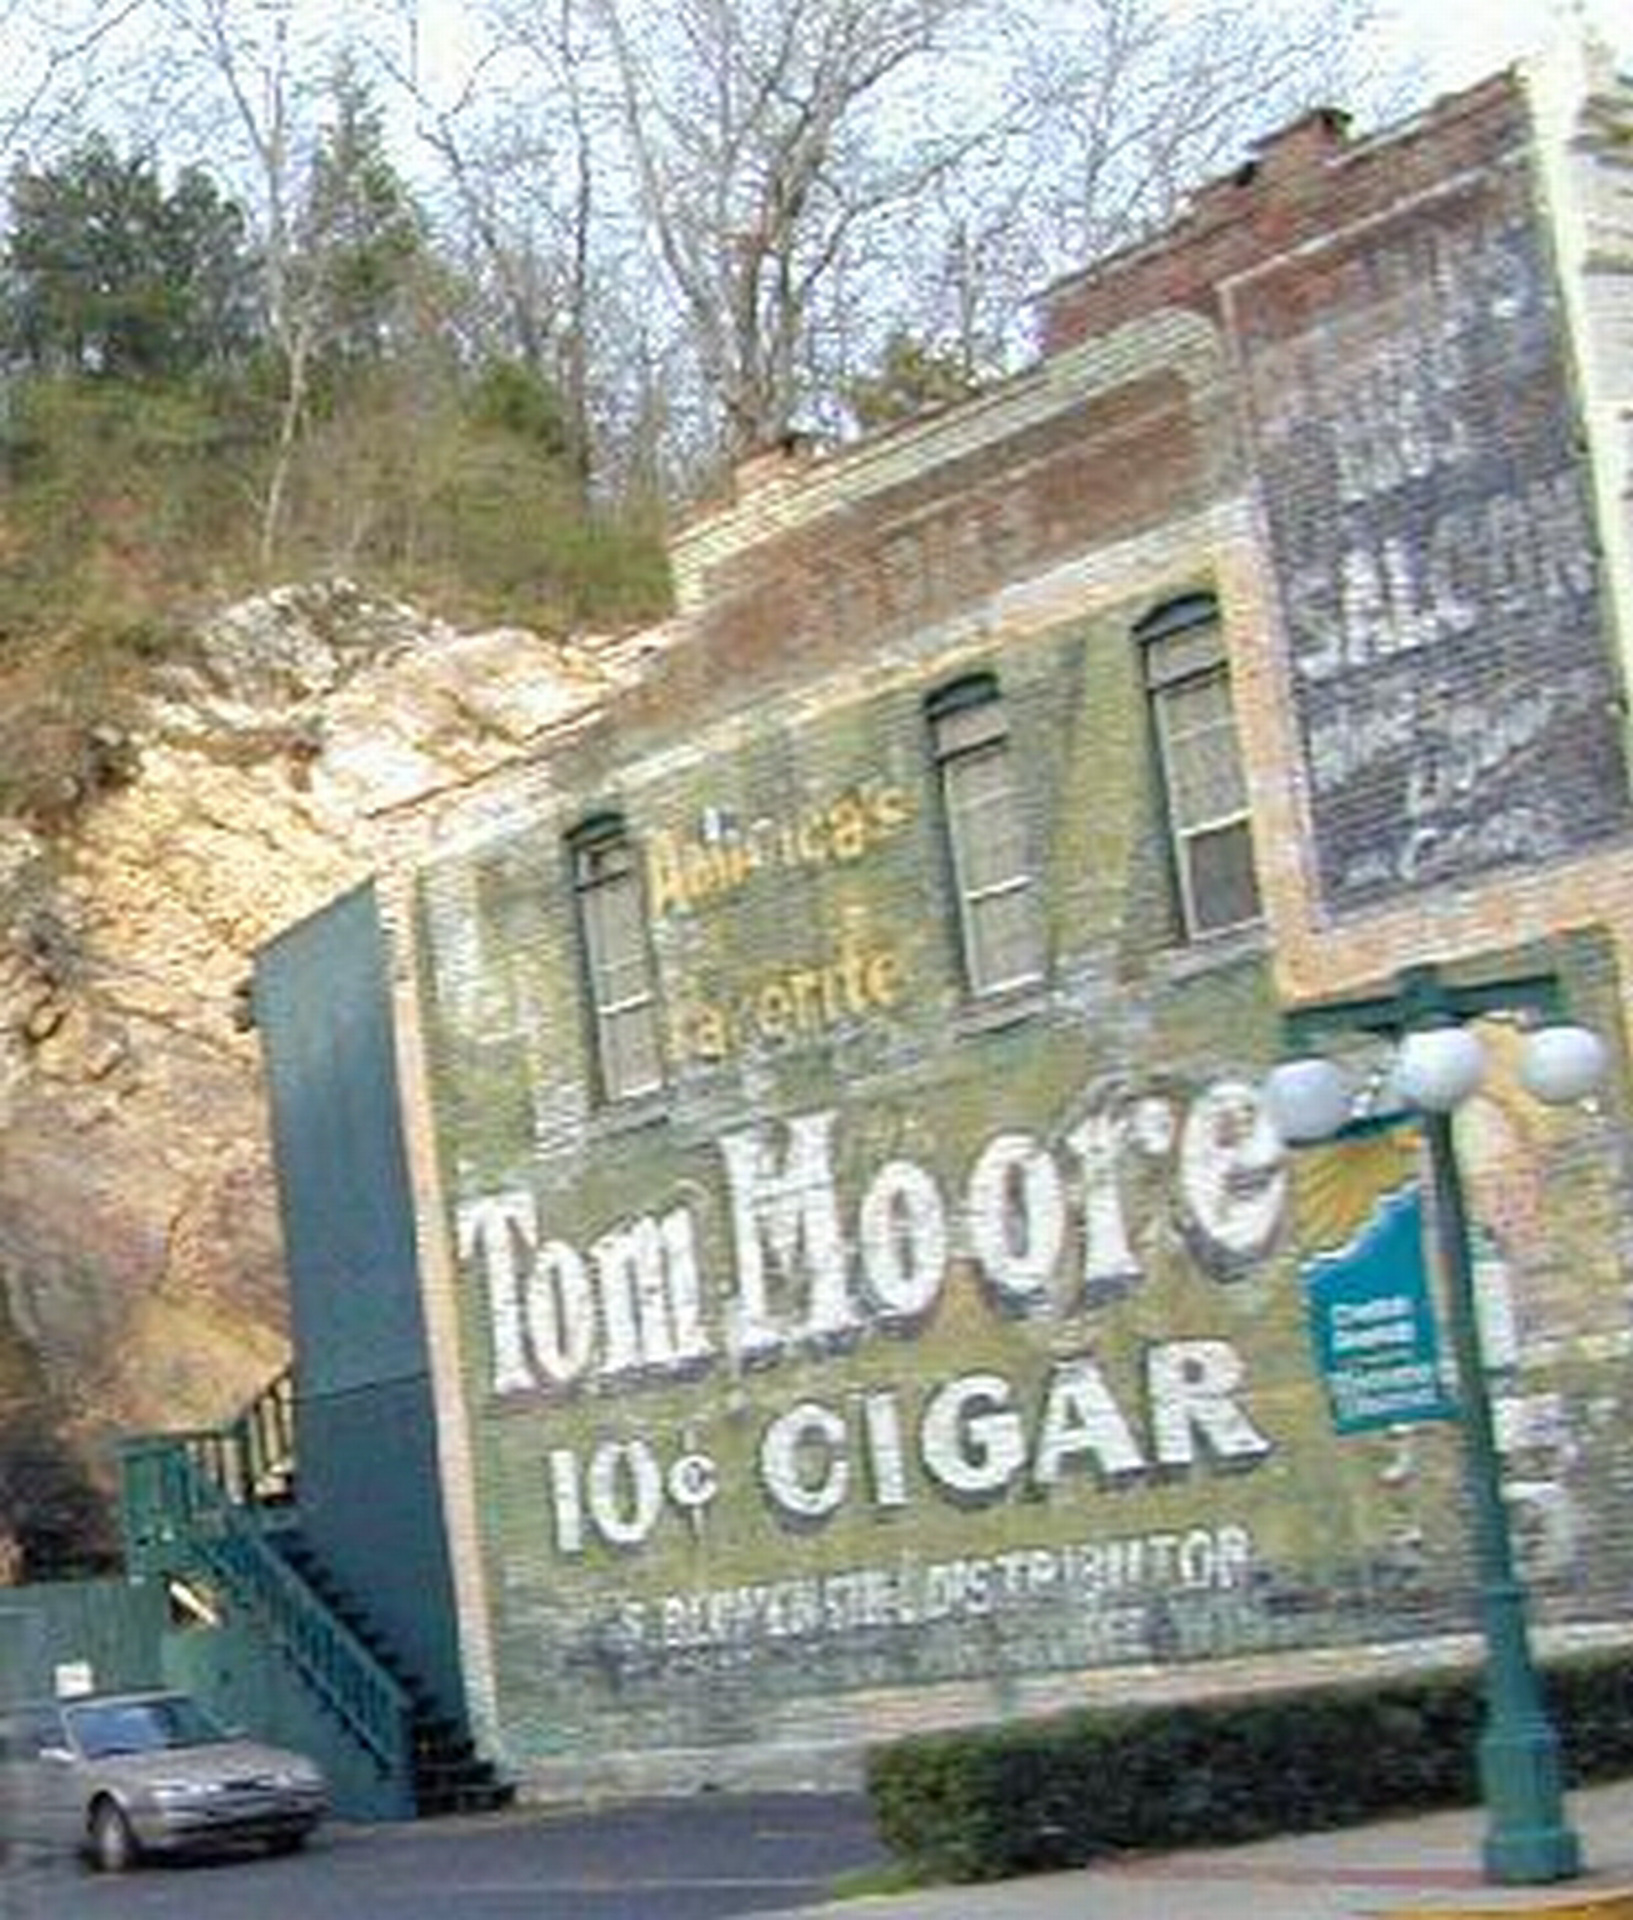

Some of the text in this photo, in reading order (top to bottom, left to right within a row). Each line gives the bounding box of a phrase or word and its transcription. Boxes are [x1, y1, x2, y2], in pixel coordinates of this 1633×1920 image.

[457, 1083, 1290, 1394] Tom Moore
[760, 1341, 1271, 1517] CIGAR
